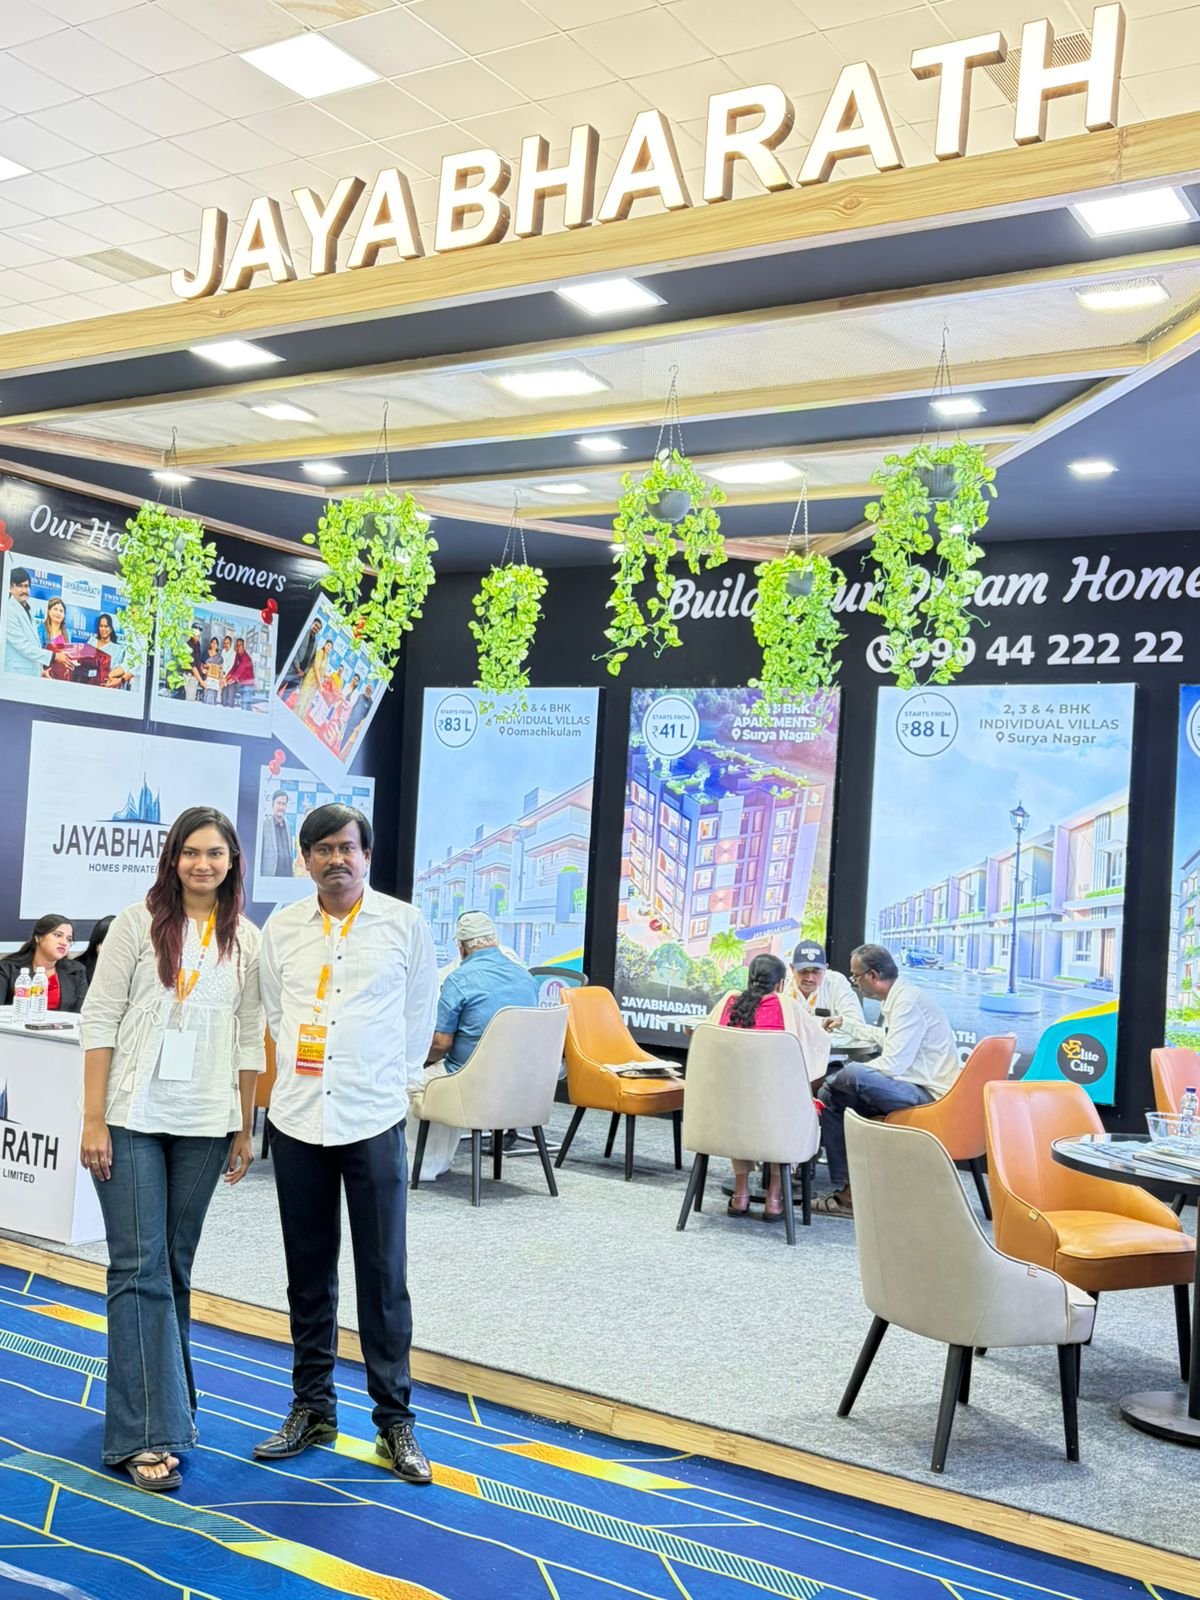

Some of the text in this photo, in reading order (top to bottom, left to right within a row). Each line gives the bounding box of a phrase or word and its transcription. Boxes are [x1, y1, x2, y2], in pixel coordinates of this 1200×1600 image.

[170, 4, 1121, 299] JAYABHARATH
[30, 504, 81, 540] Our
[908, 631, 1184, 668] 999 44 222 22
[531, 704, 537, 712] &
[540, 704, 547, 712] 4
[549, 703, 571, 713] BHK
[783, 703, 811, 714] BHK
[1004, 703, 1091, 716] 2, 3 & 4 BHK
[465, 718, 471, 732] L
[555, 715, 591, 725] VILLAS
[979, 718, 1119, 729] INDIVIDUAL VILLAS
[506, 726, 581, 737] Oomachikulam
[680, 723, 687, 738] L
[742, 729, 815, 743] Surya Nagar
[940, 721, 950, 737] L
[1007, 732, 1097, 746] Surya Nagar
[88, 863, 155, 873] HOMES PRIVATE
[621, 996, 707, 1015] JAYABHARATH
[1070, 1060, 1095, 1075] City
[3, 1168, 35, 1183] LIMITED
